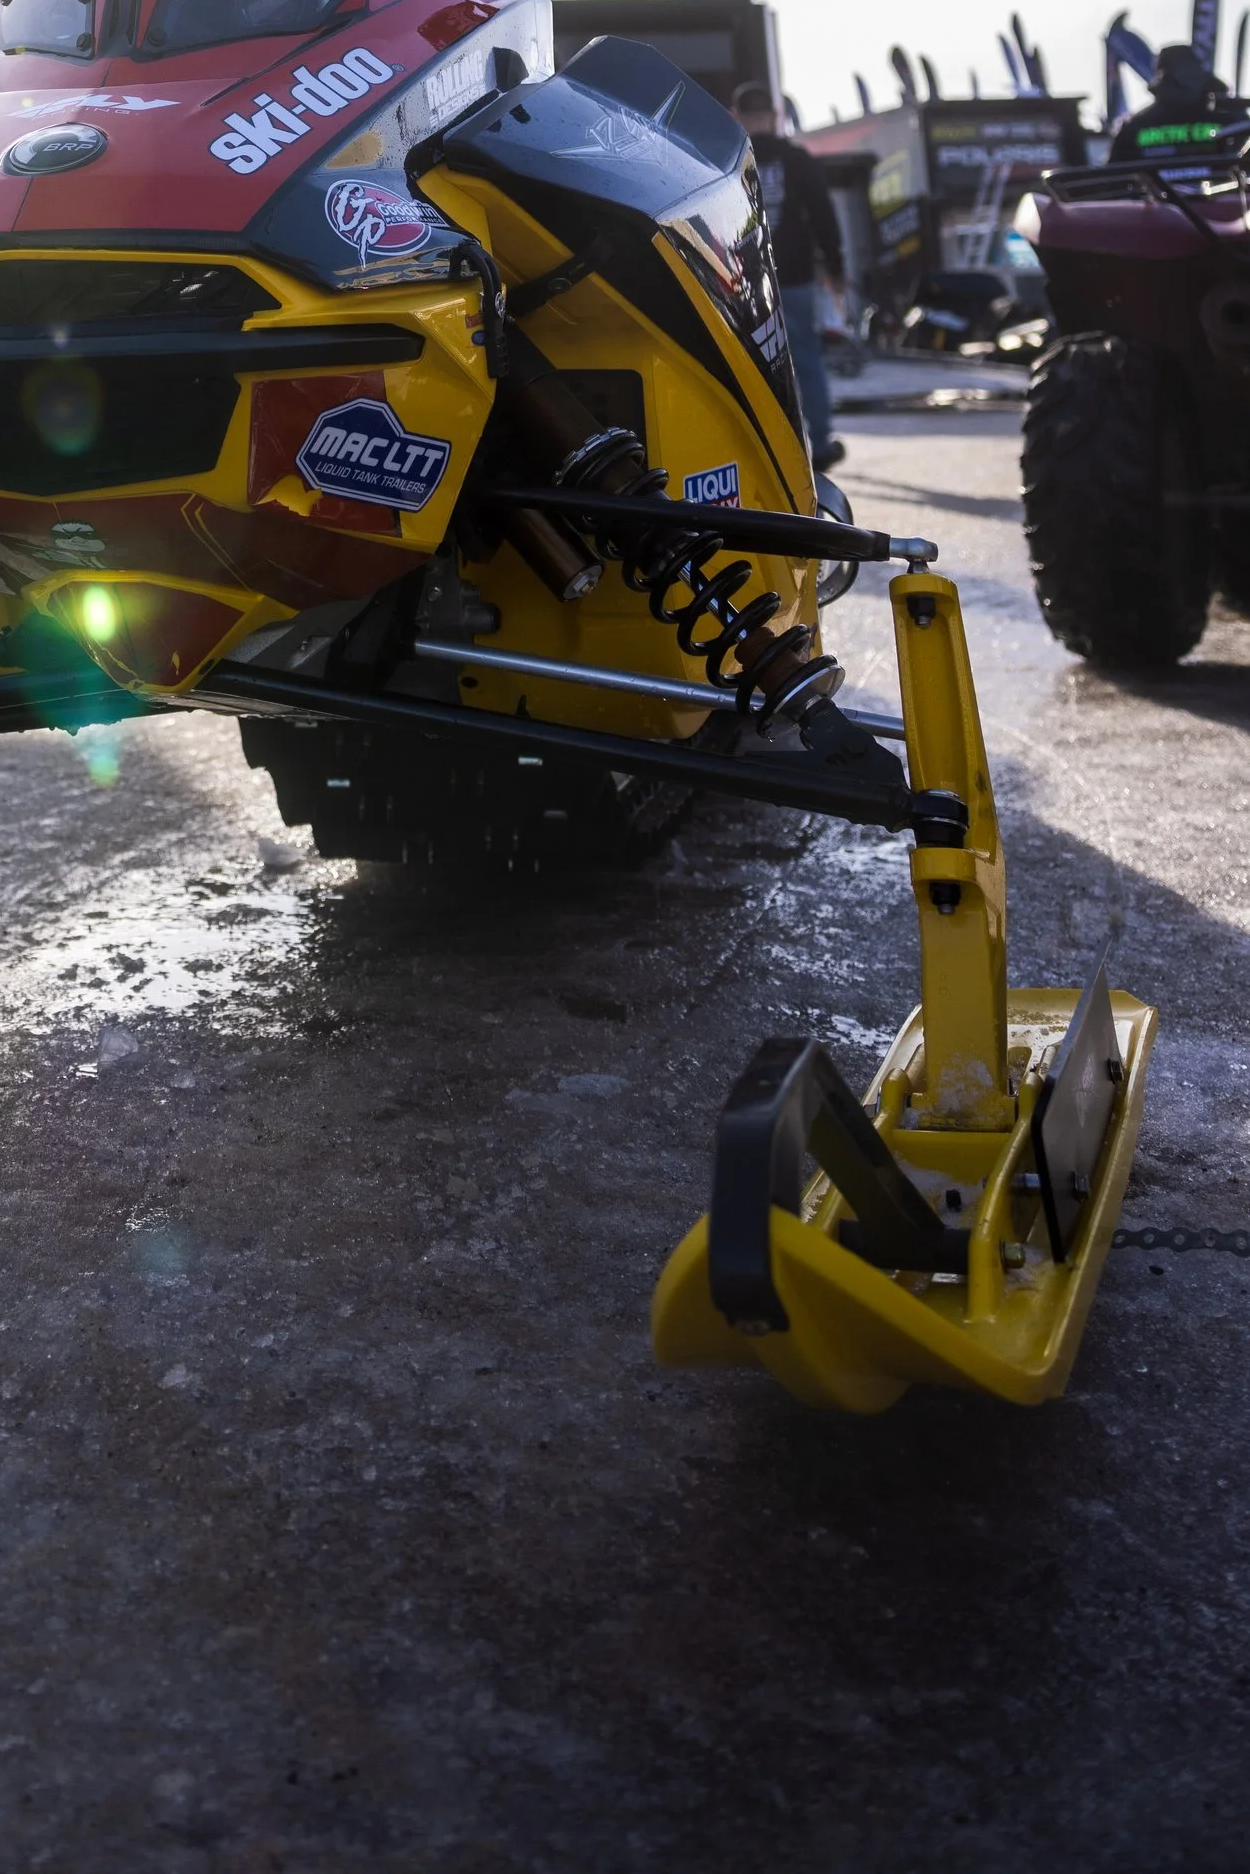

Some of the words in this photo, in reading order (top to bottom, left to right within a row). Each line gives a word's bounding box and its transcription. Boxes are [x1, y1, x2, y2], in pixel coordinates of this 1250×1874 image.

[210, 47, 394, 174] ski-doo
[43, 142, 94, 152] BRP
[314, 461, 351, 478] LIQUID
[352, 469, 381, 487] TANK
[380, 475, 426, 494] TRAILERS
[687, 467, 737, 503] LIQUI
